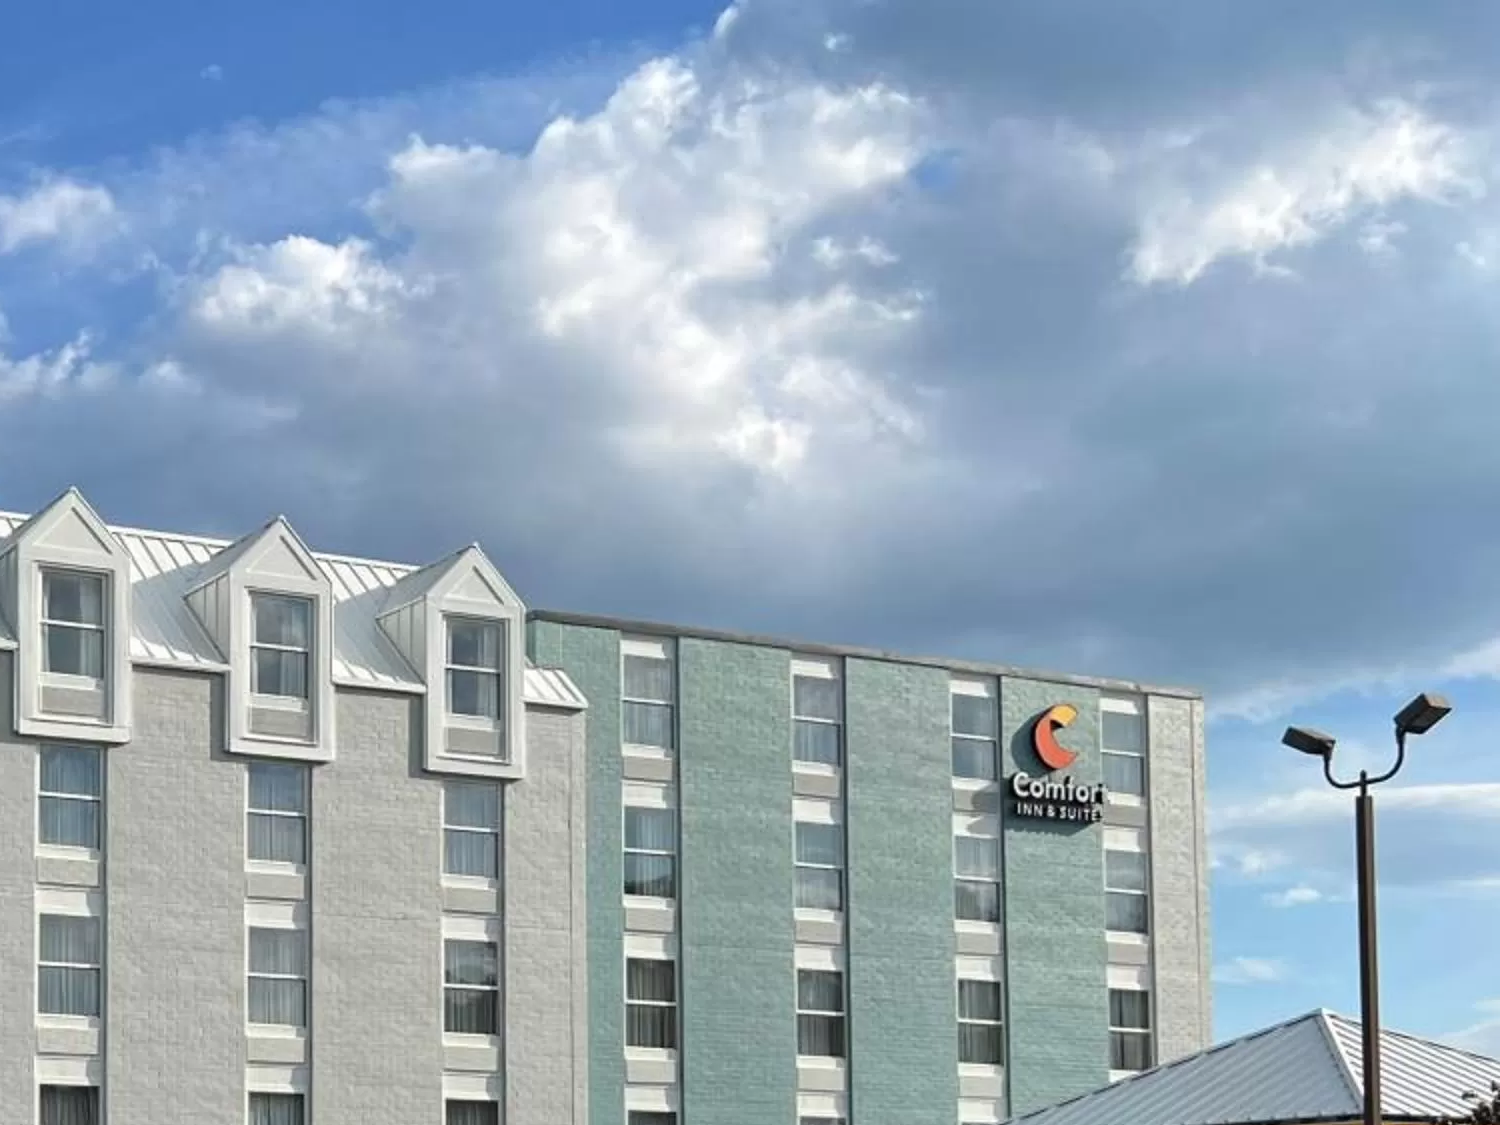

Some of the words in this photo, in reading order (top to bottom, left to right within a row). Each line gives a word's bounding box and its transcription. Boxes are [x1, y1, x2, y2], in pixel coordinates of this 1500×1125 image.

[1017, 801, 1043, 816] INN
[1046, 804, 1056, 817] &
[1059, 805, 1103, 821] SUITE
